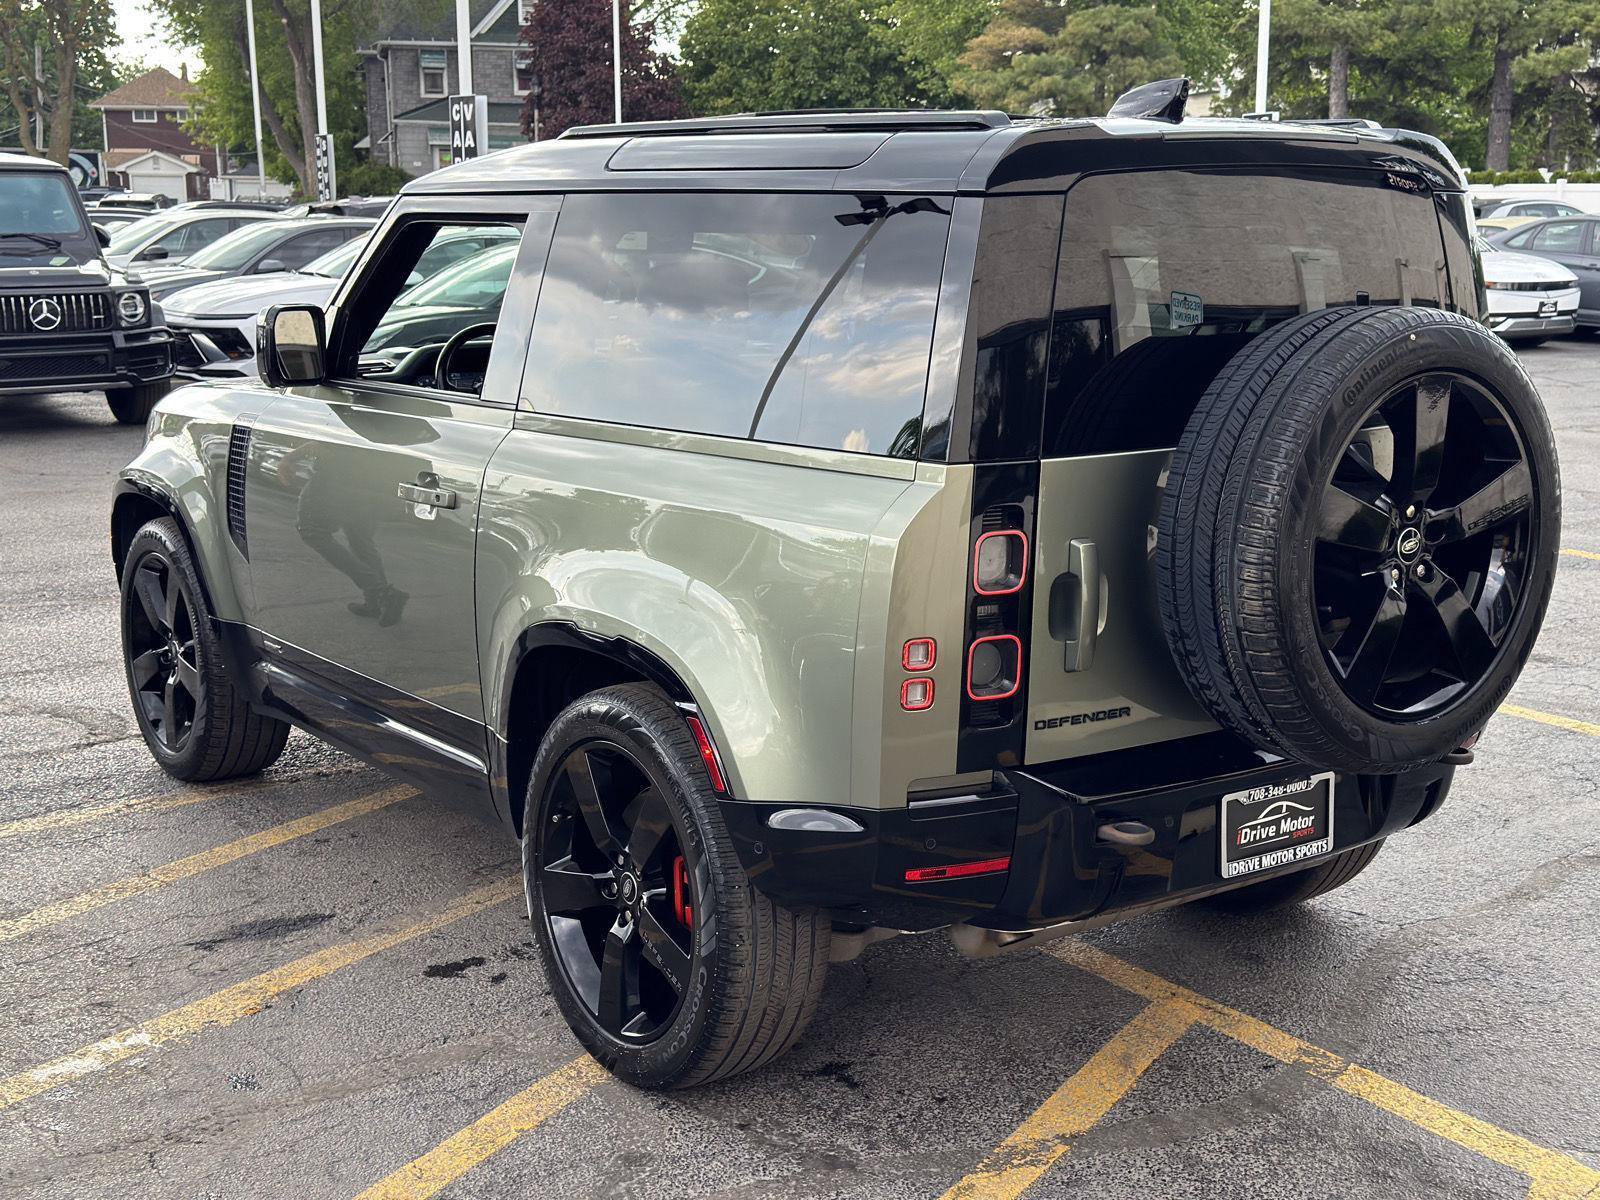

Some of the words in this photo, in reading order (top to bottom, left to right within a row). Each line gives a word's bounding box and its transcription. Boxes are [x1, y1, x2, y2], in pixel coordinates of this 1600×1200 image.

[321, 139, 331, 200] SUVS
[1033, 706, 1132, 731] DEFENDER
[1236, 825, 1277, 846] iDrive
[1279, 815, 1315, 834] Motor
[1292, 827, 1316, 839] SPORTS
[1261, 850, 1294, 868] MOTOR
[1295, 839, 1328, 859] SPORTS
